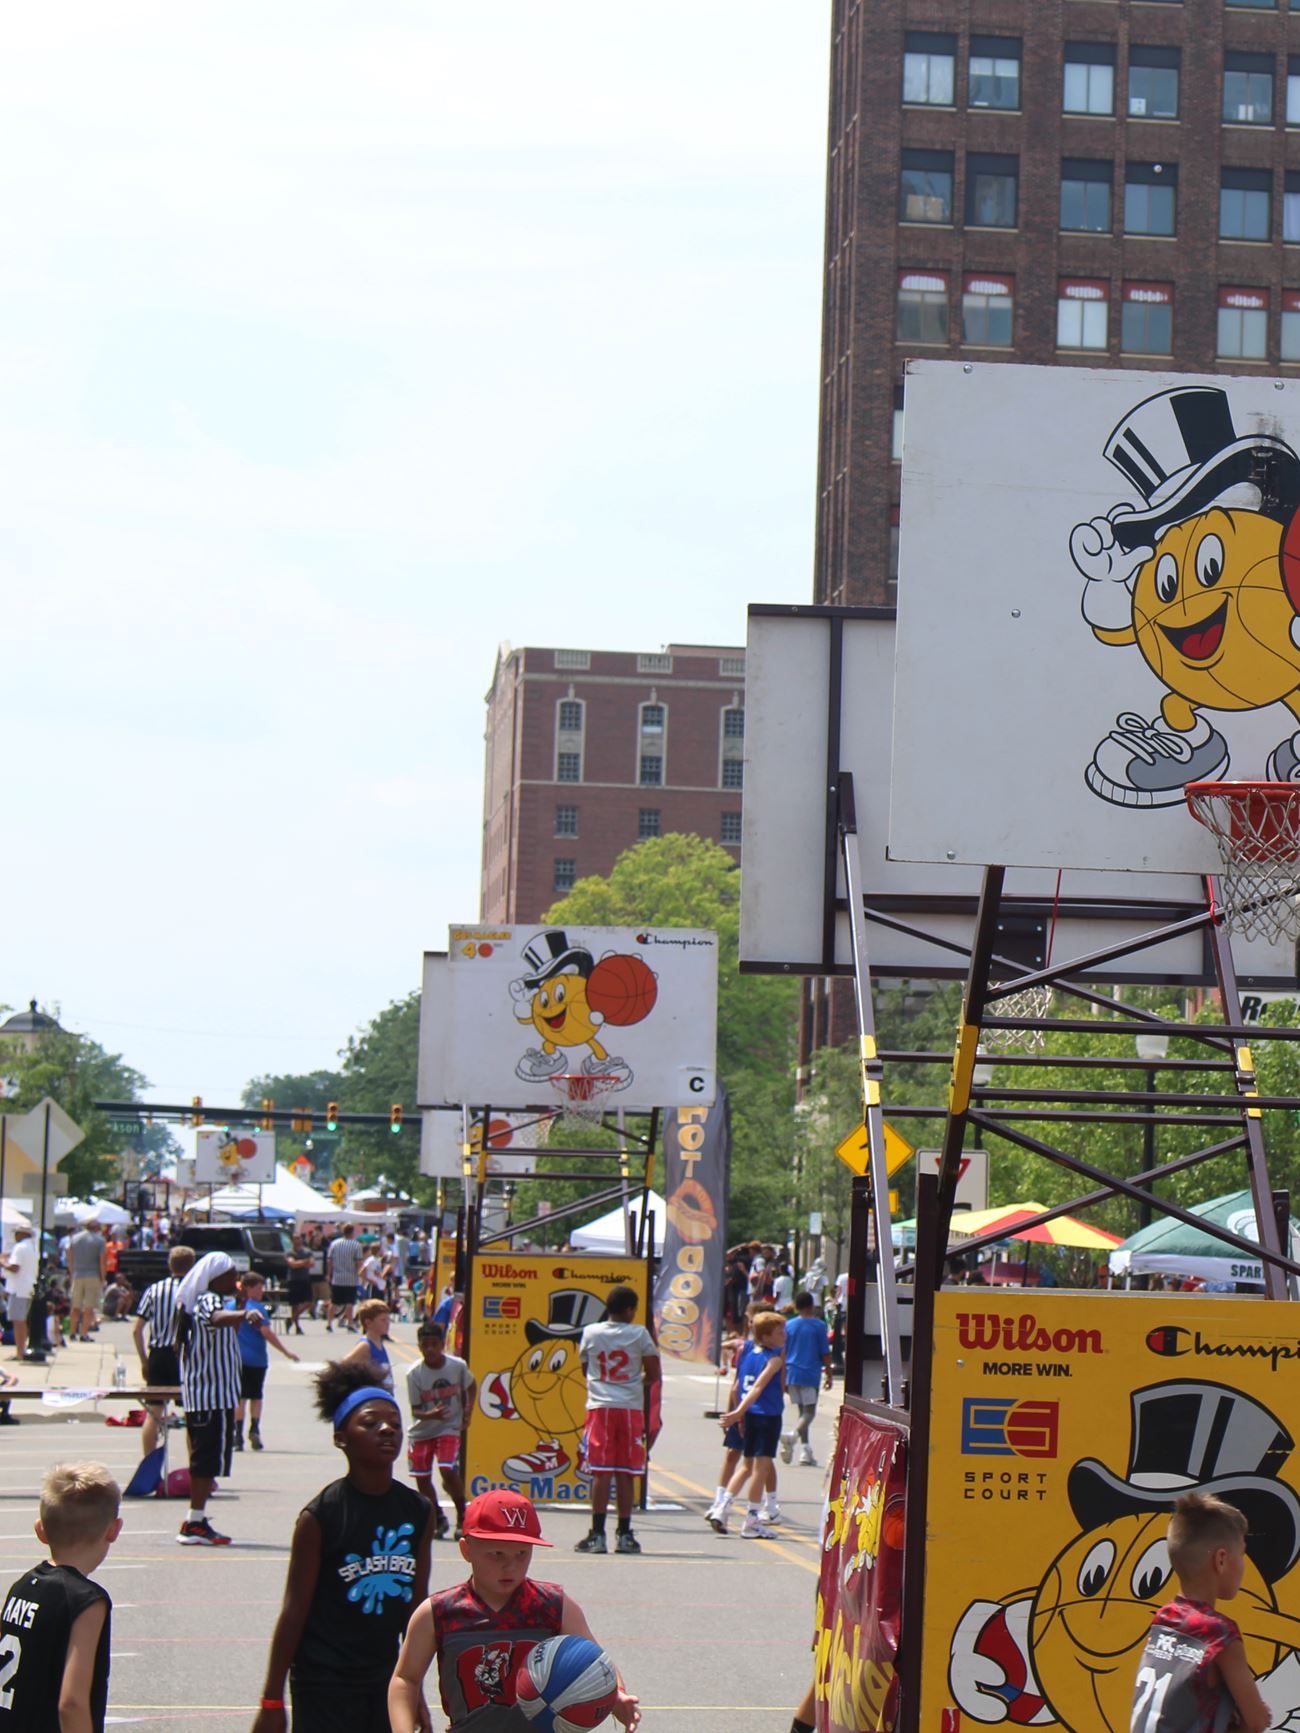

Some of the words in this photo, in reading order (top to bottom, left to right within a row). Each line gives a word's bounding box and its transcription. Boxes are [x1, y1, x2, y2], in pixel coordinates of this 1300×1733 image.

[636, 933, 714, 949] Champion
[689, 1076, 705, 1092] C
[481, 1264, 538, 1279] Wilson
[552, 1267, 632, 1283] Champion
[1231, 1264, 1262, 1279] SPAR
[956, 1313, 1103, 1354] Wilson
[597, 1348, 631, 1383] 12
[982, 1361, 1033, 1376] MORE
[1036, 1363, 1073, 1377] WIN.
[964, 1471, 1048, 1484] SPORT
[963, 1488, 1048, 1501] COURT
[501, 1507, 528, 1528] W
[338, 1555, 389, 1582] SPLASH
